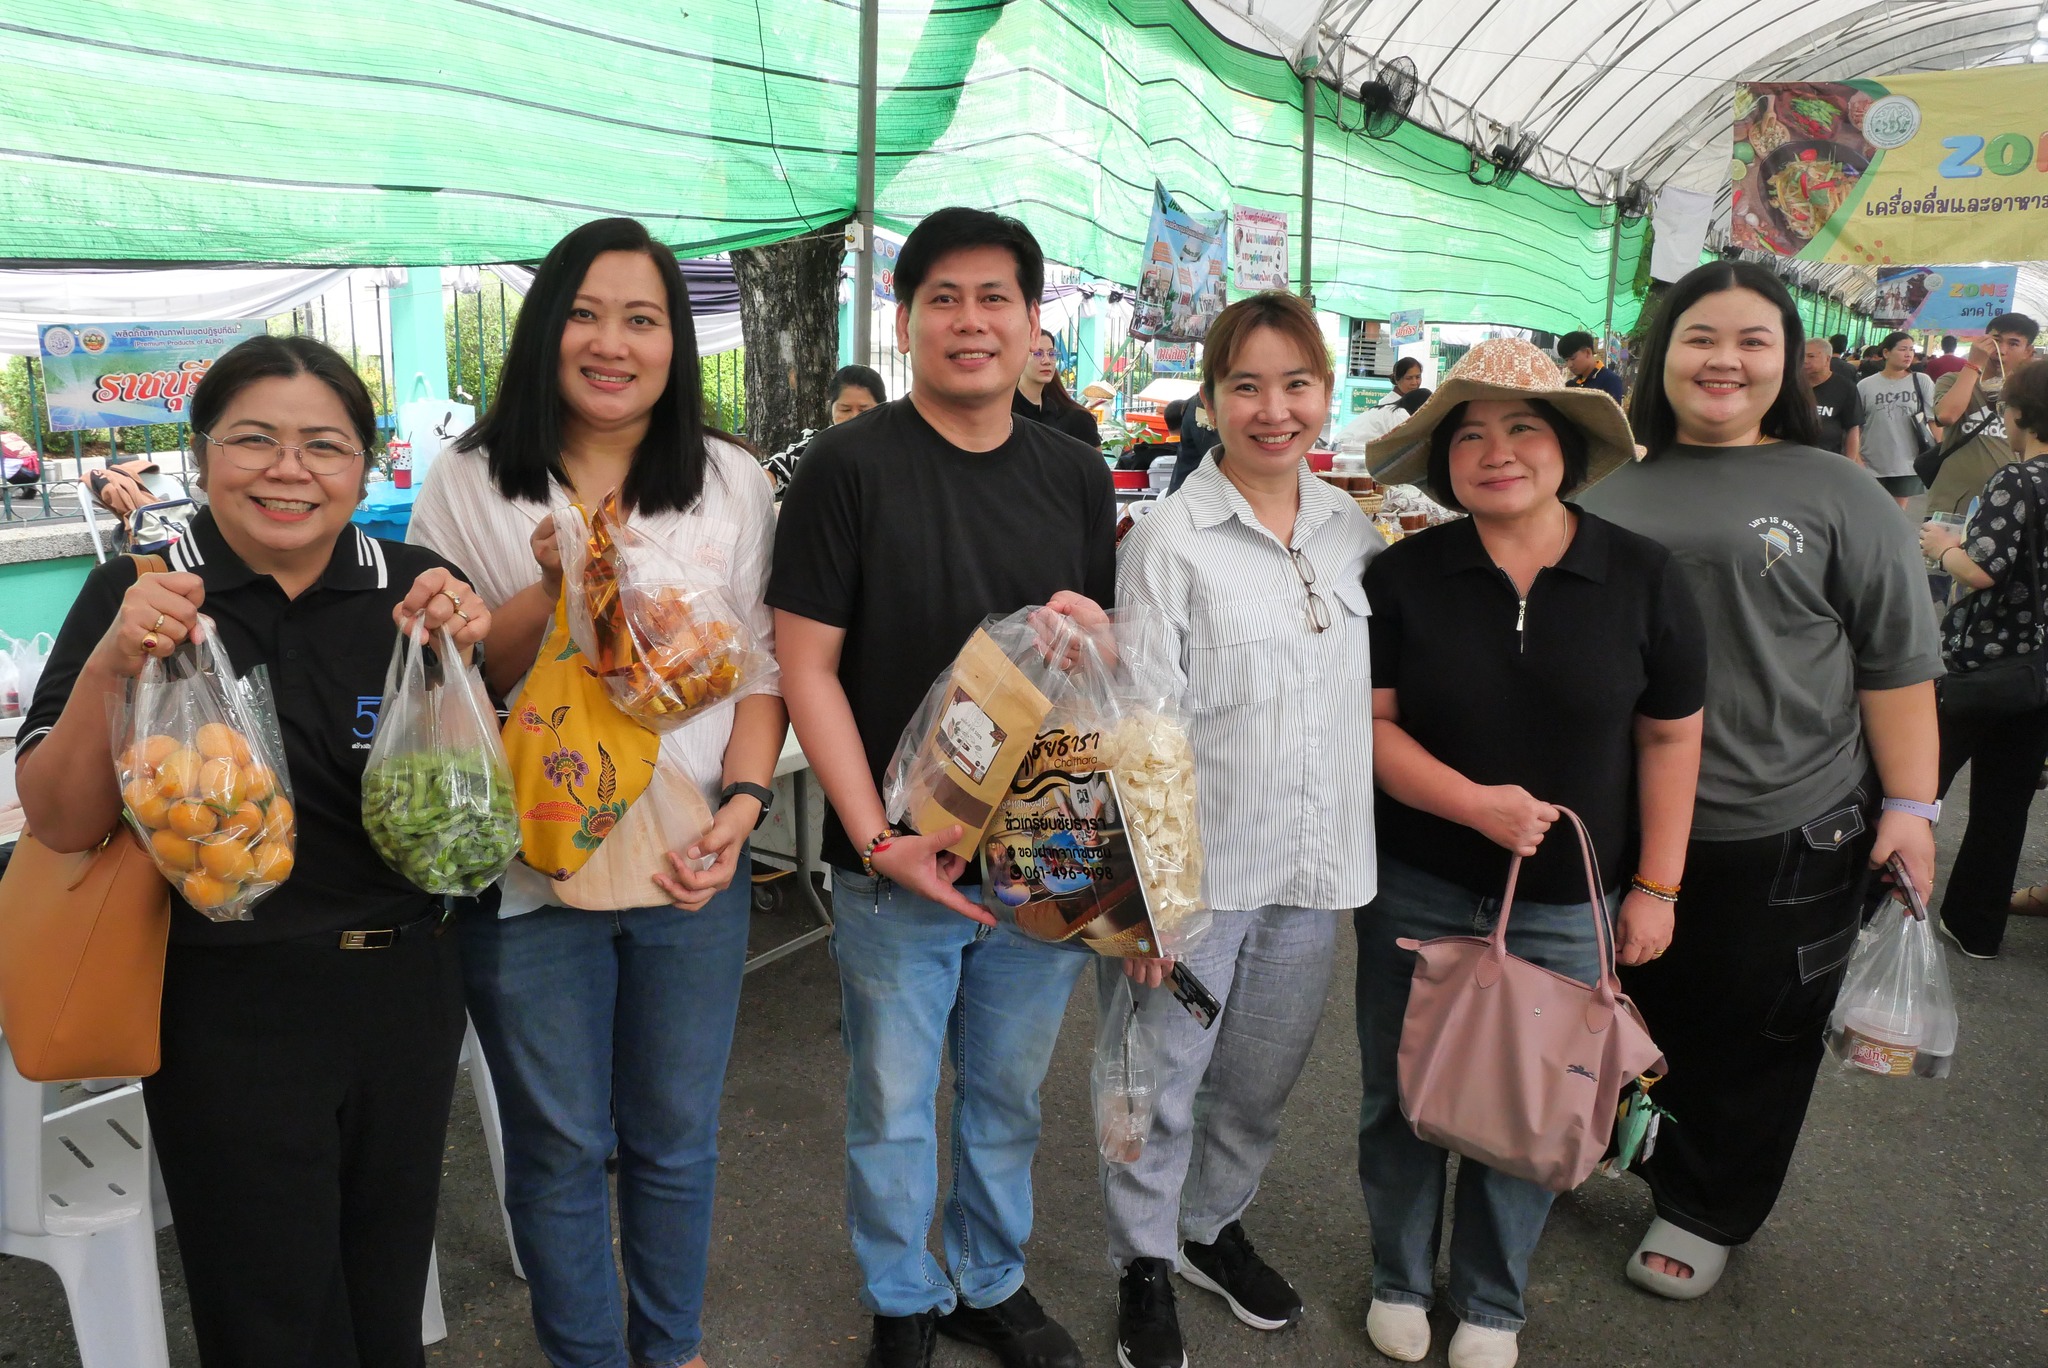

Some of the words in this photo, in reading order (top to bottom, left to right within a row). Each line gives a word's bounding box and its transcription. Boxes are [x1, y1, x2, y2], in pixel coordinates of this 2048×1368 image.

[1938, 130, 2048, 179] ZO
[1949, 283, 2009, 298] ZONE
[1961, 299, 2006, 317] ภาคใต้
[1748, 517, 1767, 528] LIFE
[1769, 516, 1779, 524] IS
[1781, 519, 1804, 554] BETTER
[1024, 865, 1114, 881] 061-496-9198
